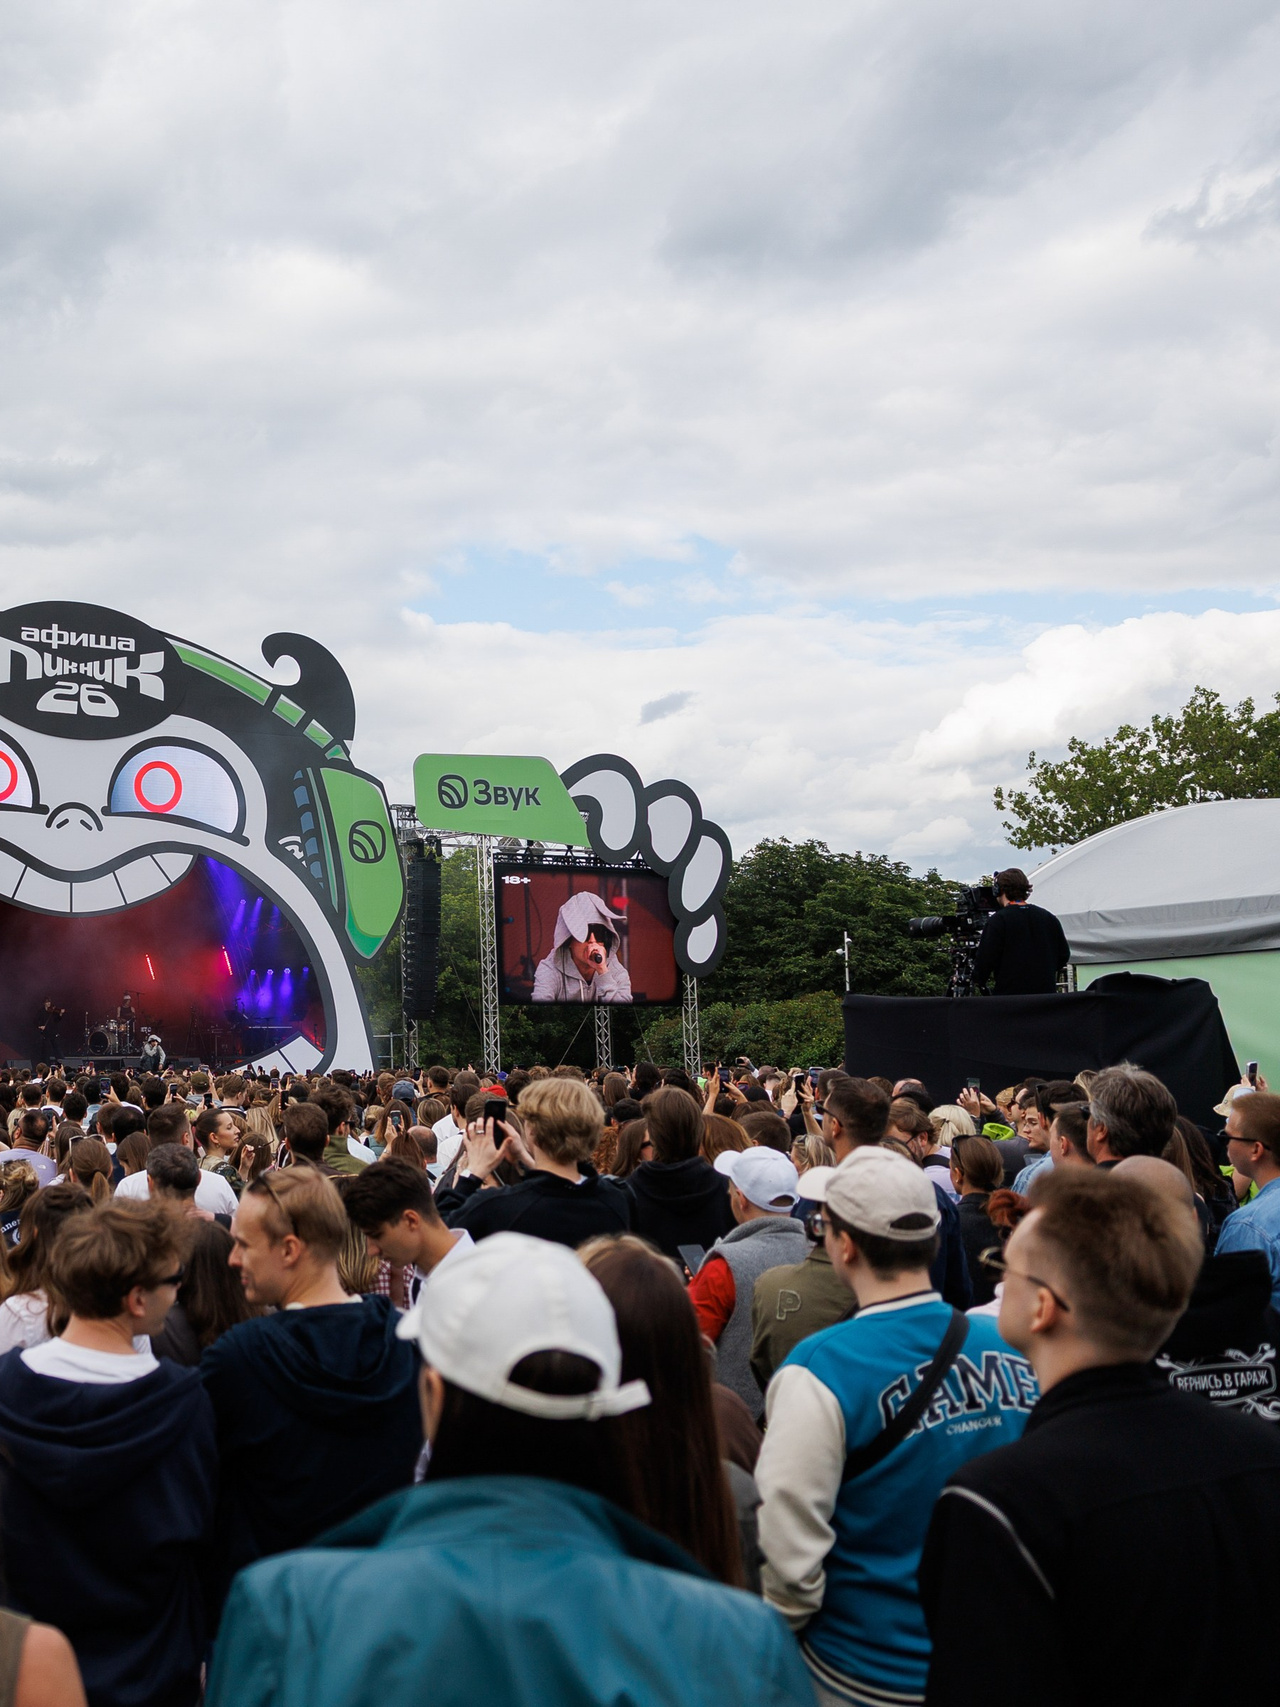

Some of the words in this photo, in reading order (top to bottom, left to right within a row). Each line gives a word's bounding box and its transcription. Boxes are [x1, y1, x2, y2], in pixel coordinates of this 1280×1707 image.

[21, 623, 135, 651] афиша
[36, 681, 120, 718] 26
[473, 779, 541, 811] Звук
[501, 875, 531, 884] 18+
[0, 1218, 21, 1234] nner
[776, 1289, 801, 1320] P
[1223, 1373, 1233, 1388] В
[1234, 1369, 1269, 1387] ГАРАЖ
